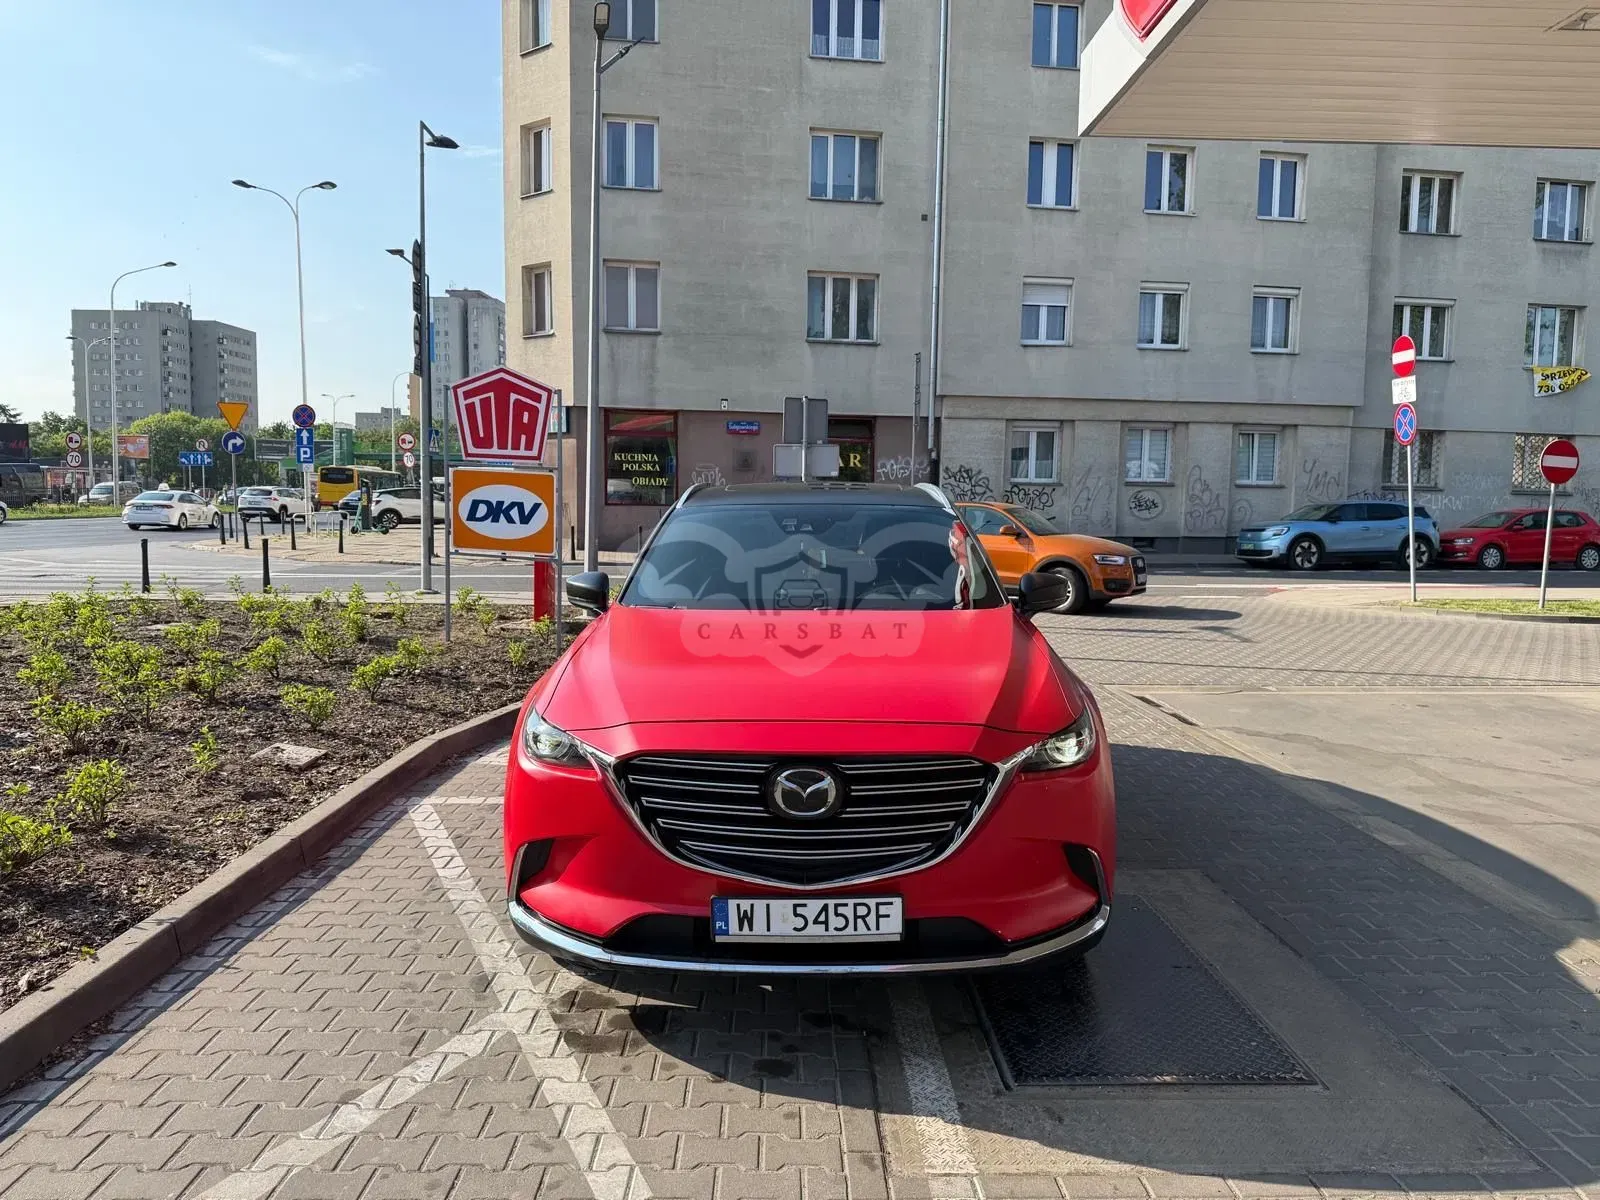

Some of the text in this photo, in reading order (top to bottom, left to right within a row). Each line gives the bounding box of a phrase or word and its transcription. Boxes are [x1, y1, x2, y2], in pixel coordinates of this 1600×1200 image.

[462, 376, 542, 451] UTA
[69, 454, 80, 464] 70
[300, 447, 310, 462] P
[614, 453, 659, 462] KUCHNIA
[622, 463, 660, 472] POLSKA
[632, 476, 669, 487] OBIADY
[466, 499, 542, 526] DKV
[736, 902, 894, 932] WI 545RF
[715, 921, 728, 930] PL
